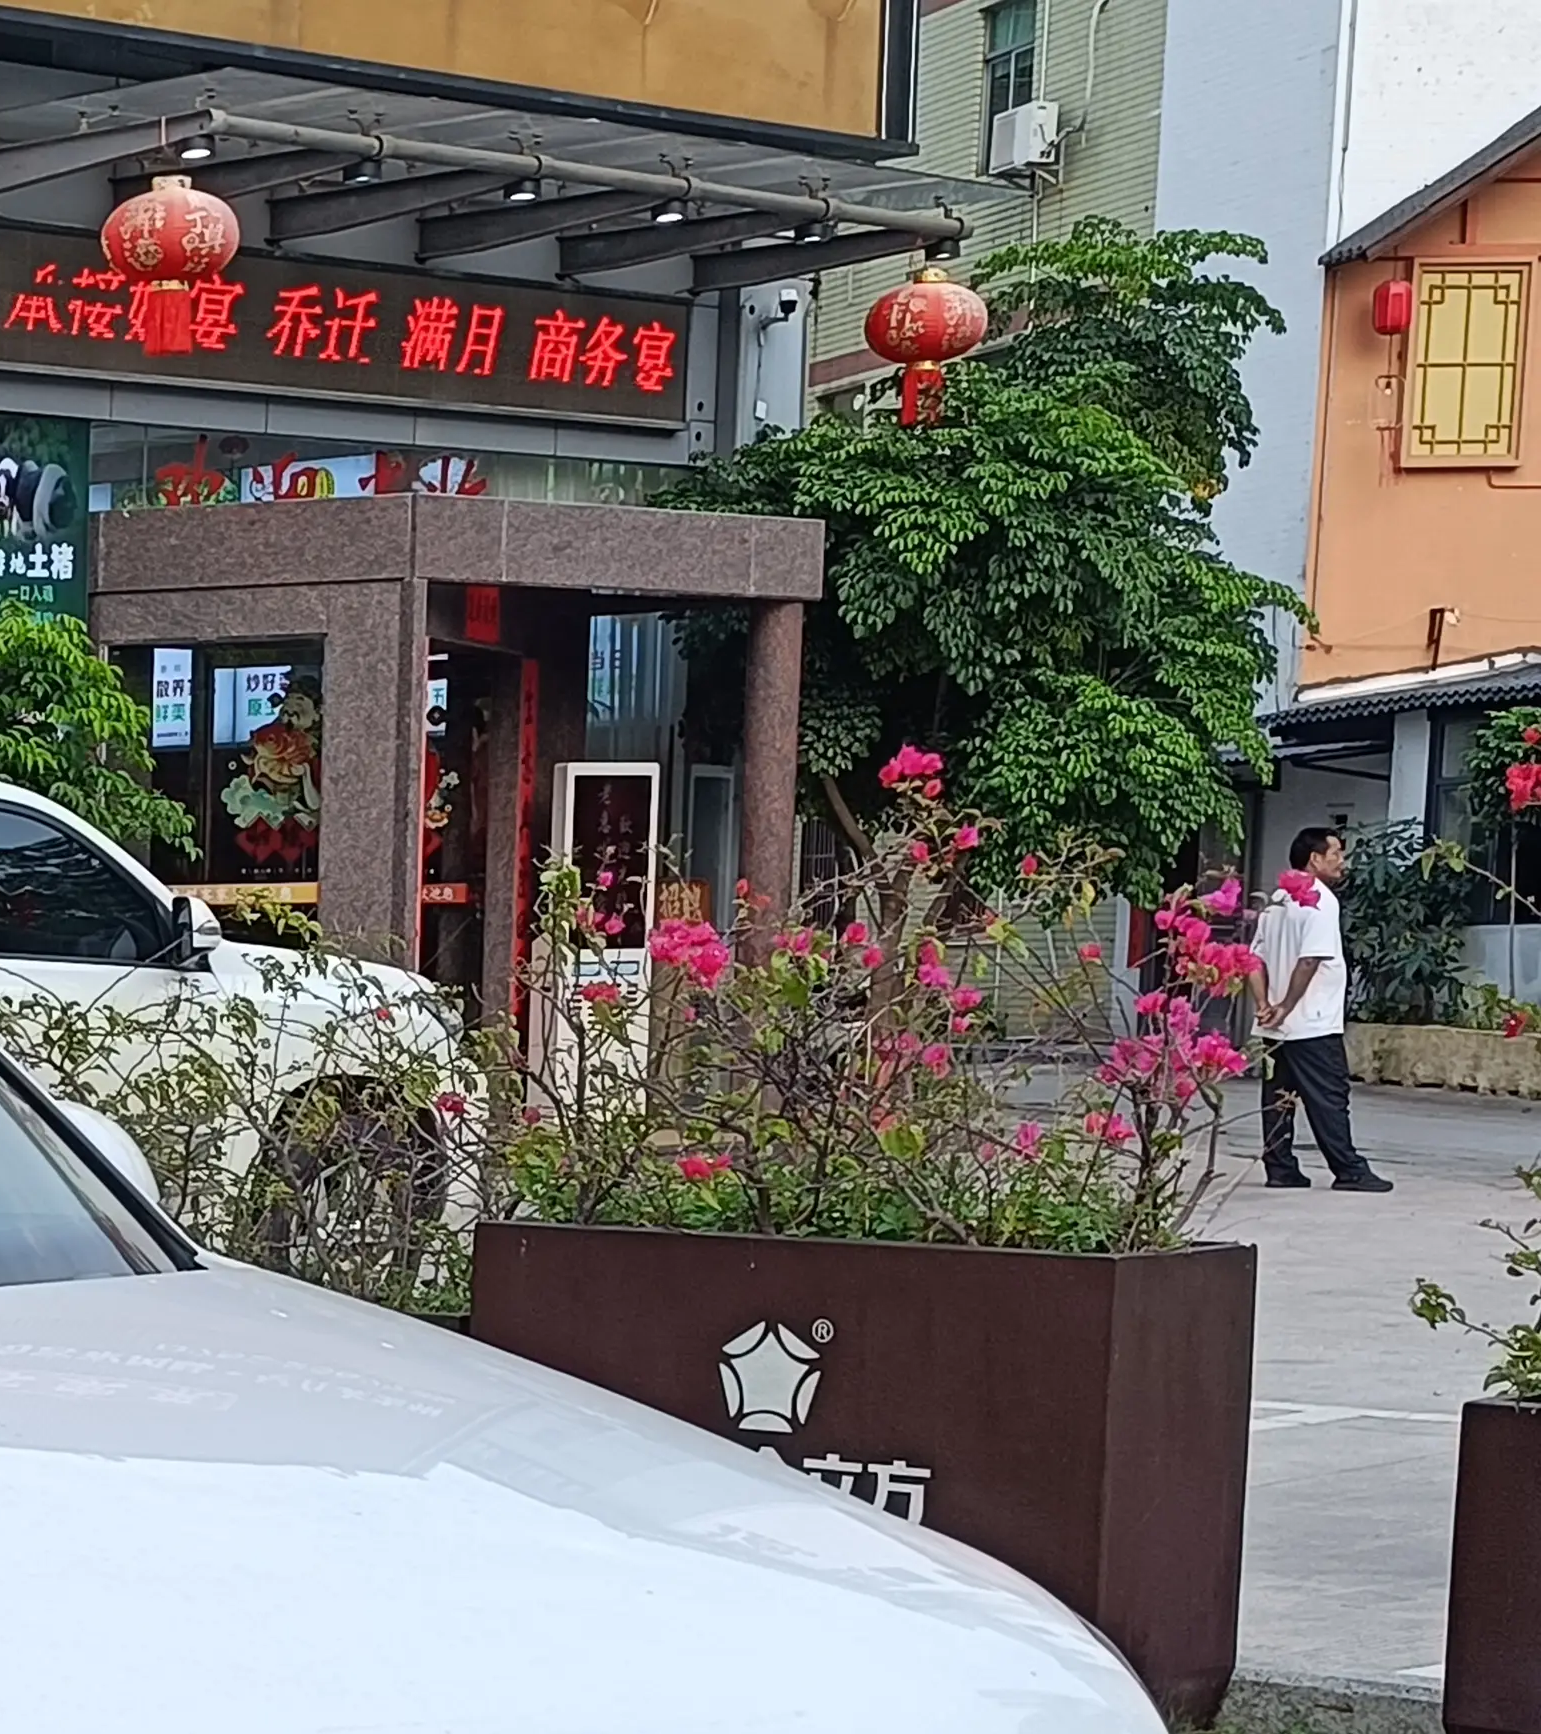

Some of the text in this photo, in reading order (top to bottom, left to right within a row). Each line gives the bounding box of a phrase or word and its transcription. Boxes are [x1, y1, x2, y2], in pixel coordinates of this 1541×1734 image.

[266, 285, 381, 366] 乔迁
[400, 294, 505, 377] 满月
[527, 308, 677, 393] 商务宴
